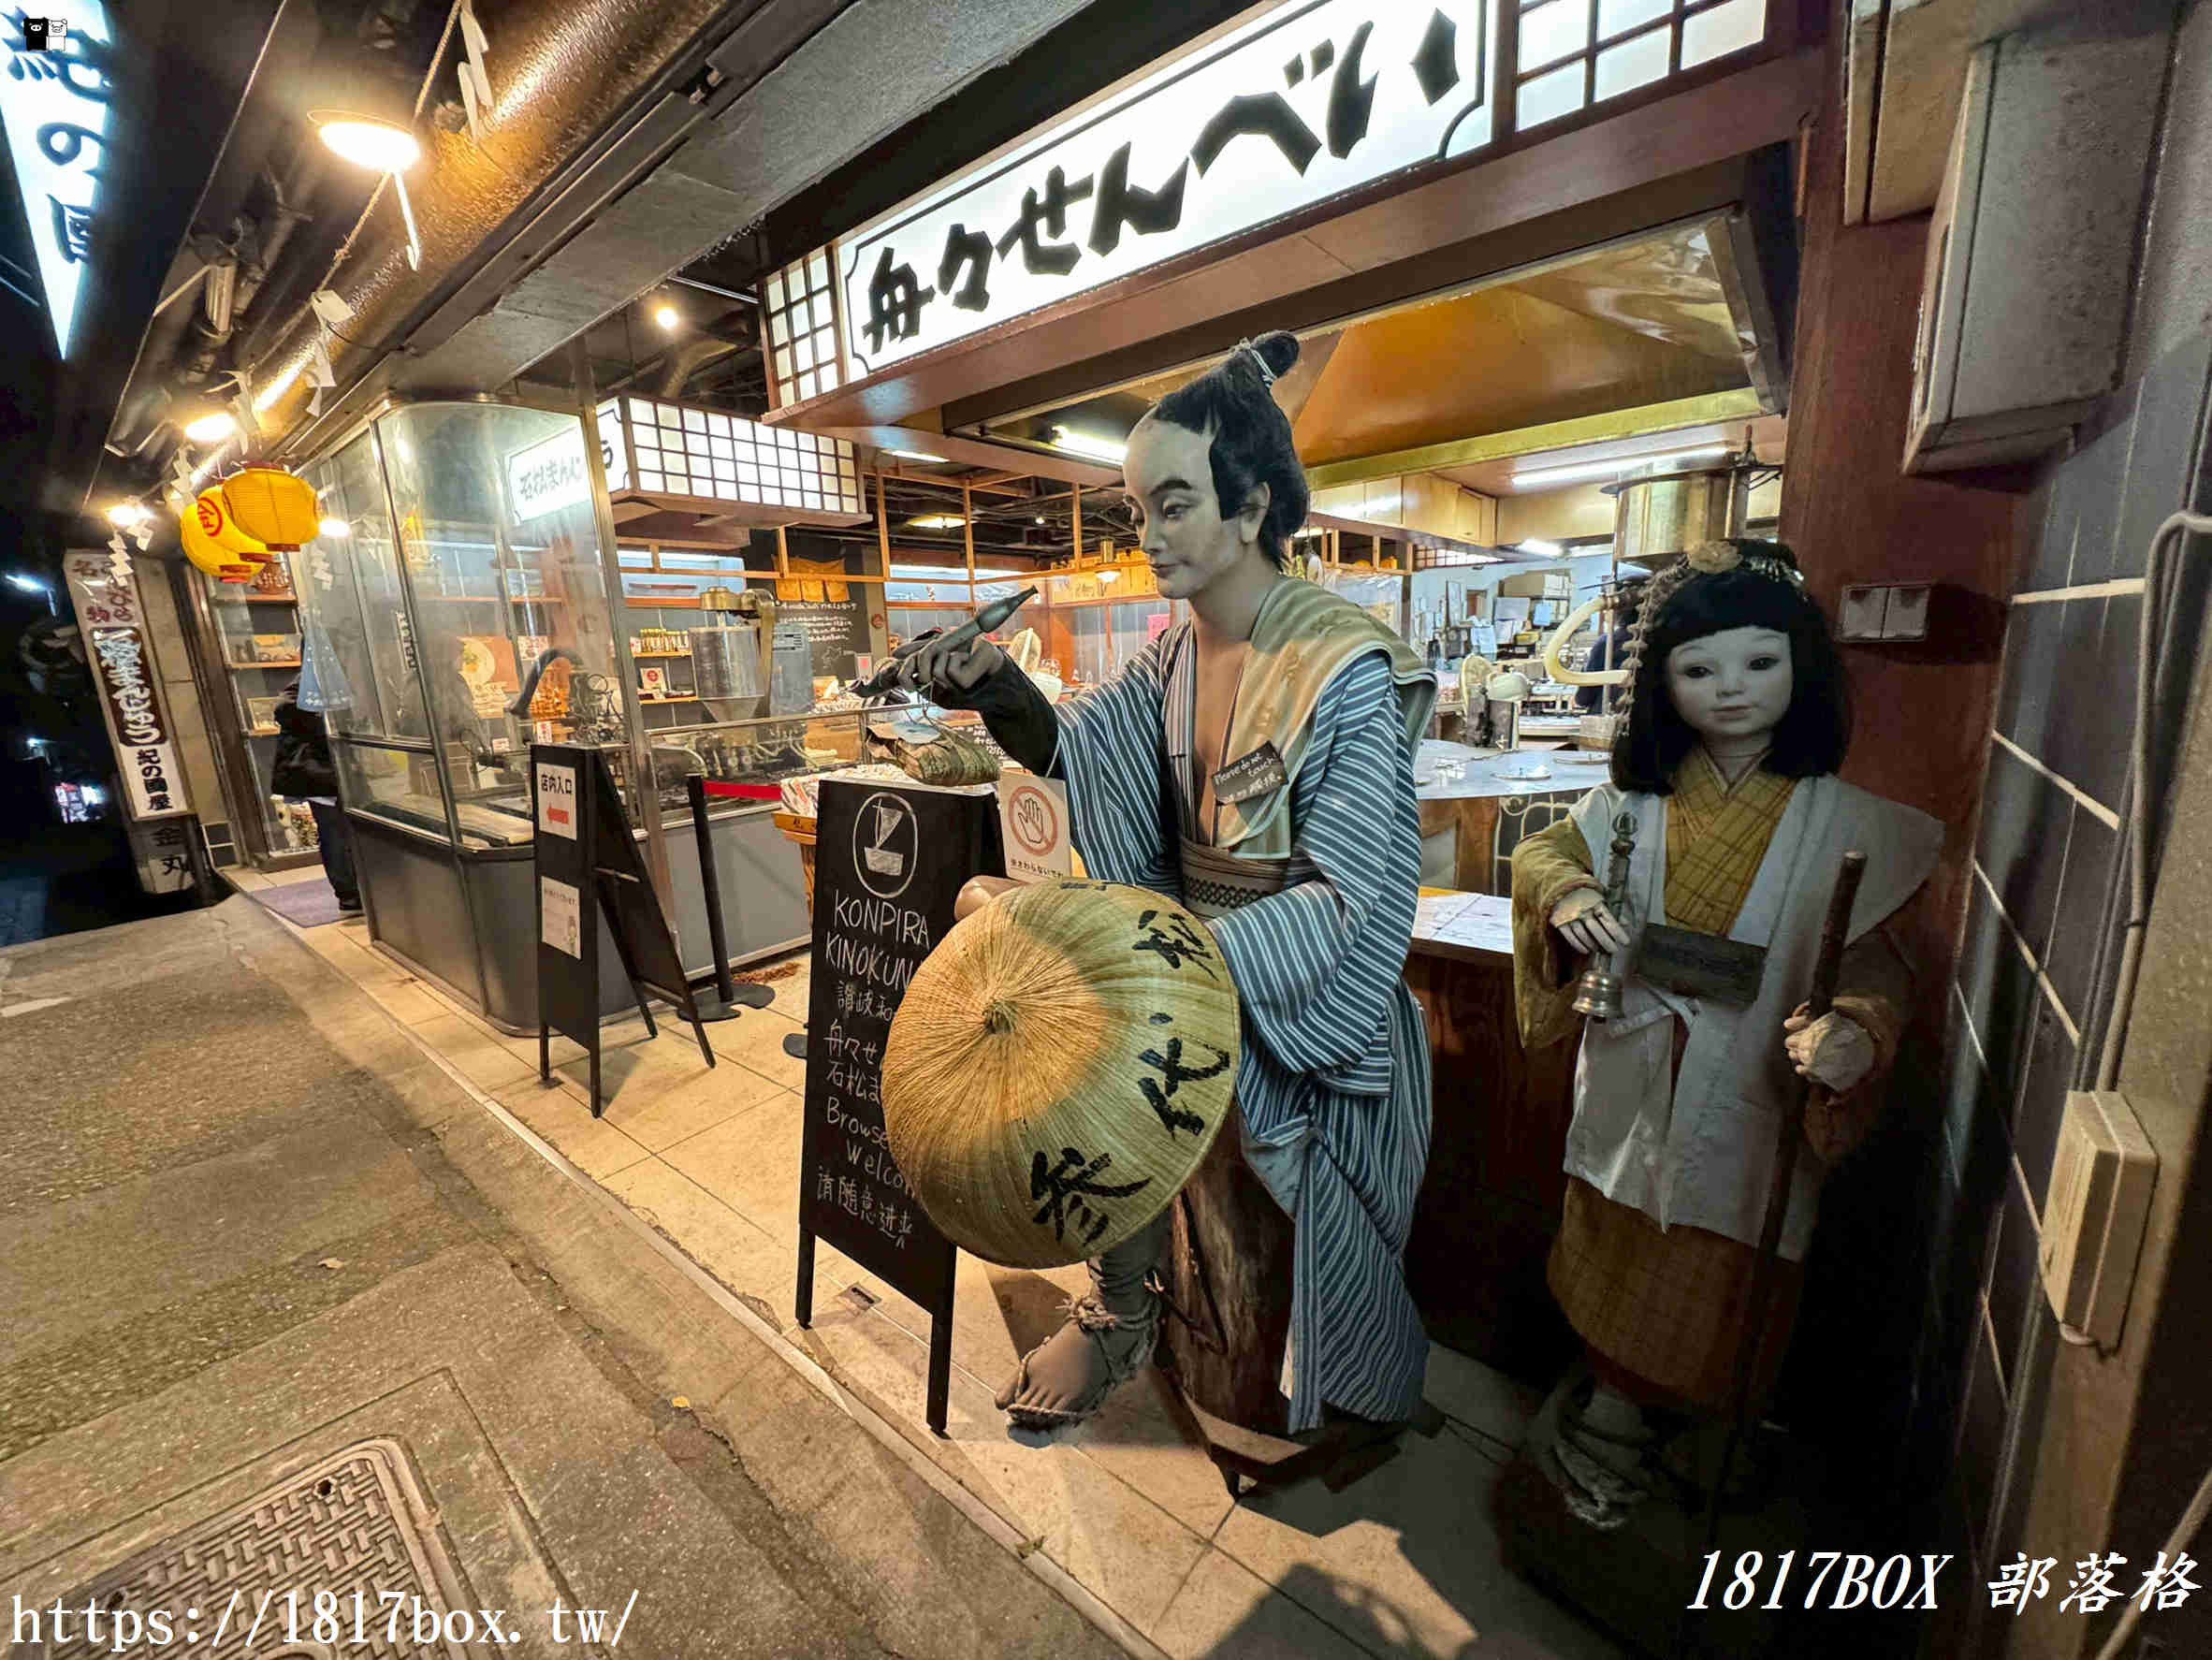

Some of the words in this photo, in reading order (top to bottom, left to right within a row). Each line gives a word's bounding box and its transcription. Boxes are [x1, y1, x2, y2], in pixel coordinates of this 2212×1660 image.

[863, 7, 1461, 355] 舟々せんべい
[541, 773, 573, 794] 店内入口
[834, 889, 930, 951] KONPIRA
[825, 931, 922, 991] KINOKUN
